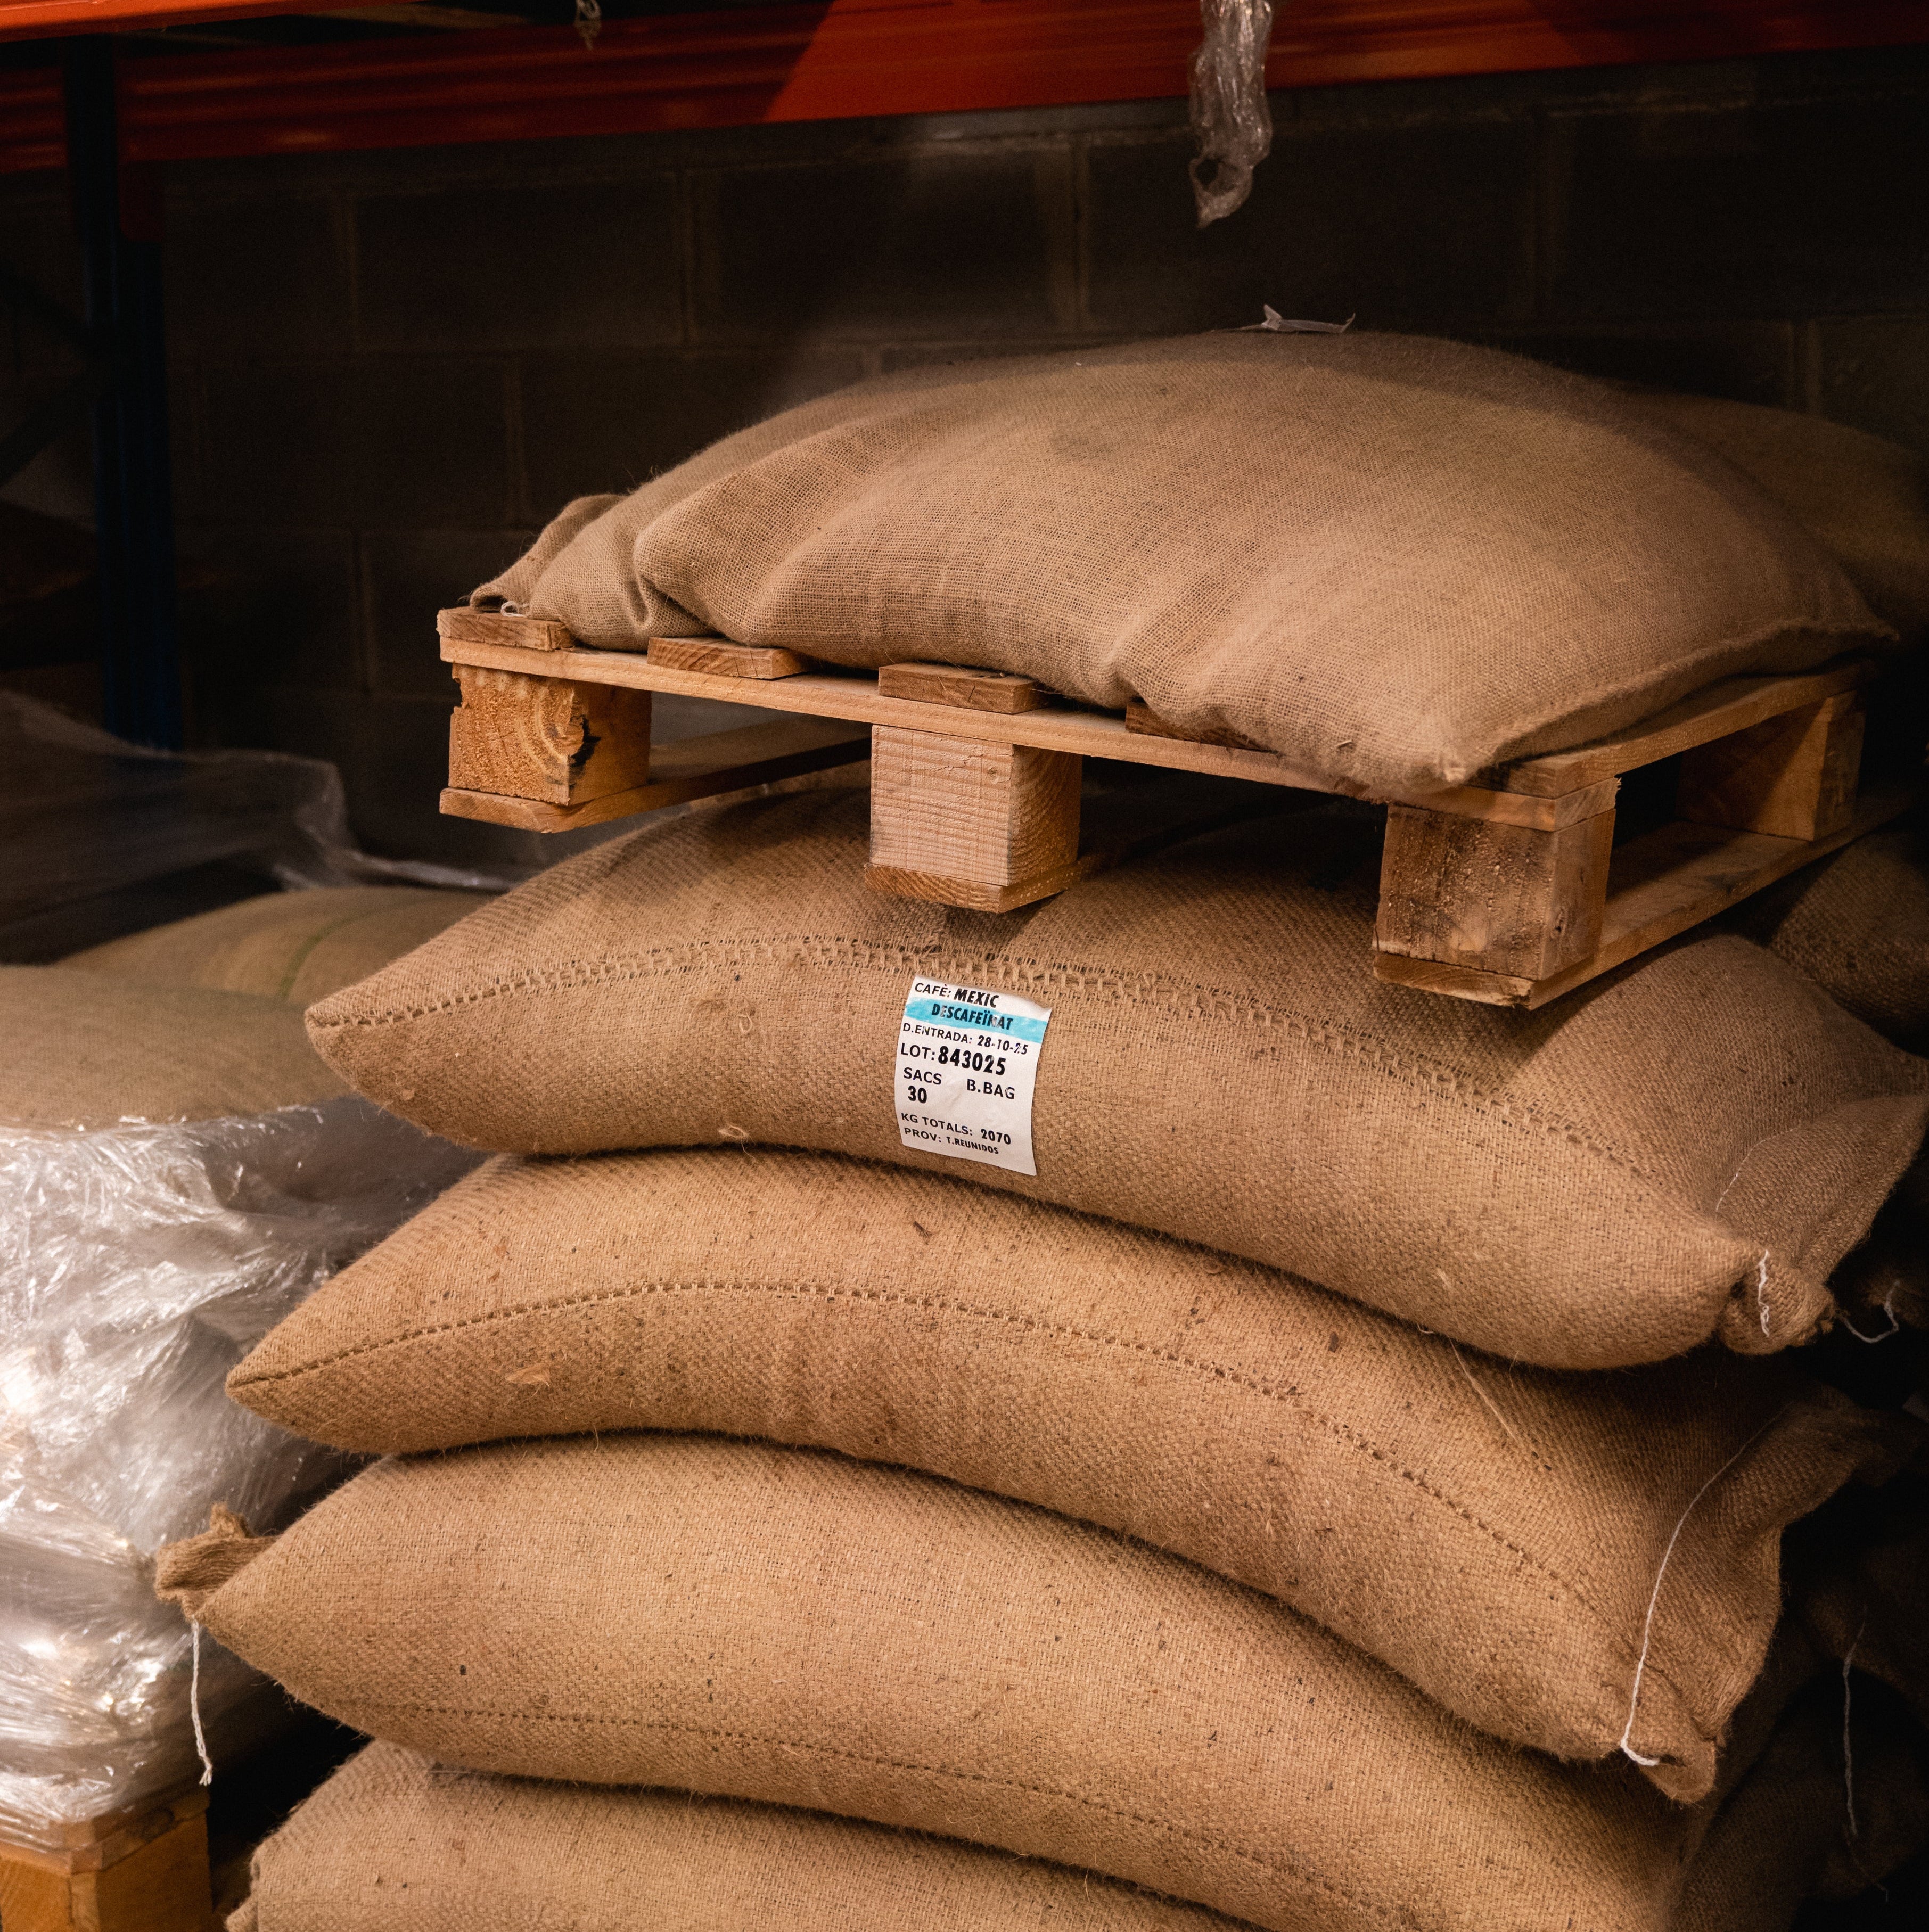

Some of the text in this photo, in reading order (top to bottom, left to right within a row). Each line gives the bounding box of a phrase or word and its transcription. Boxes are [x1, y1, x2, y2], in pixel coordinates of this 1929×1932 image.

[915, 983, 999, 1008] CAFÈ: MEXIC
[903, 1023, 1028, 1055] D.ENTRADA: 28-10-25
[904, 1067, 1015, 1099] SACS B.BAG
[908, 1086, 927, 1104] 30
[901, 1113, 1011, 1145] KG TOTALS: 2070
[905, 1128, 998, 1154] PROV: T.REUNIDOS
